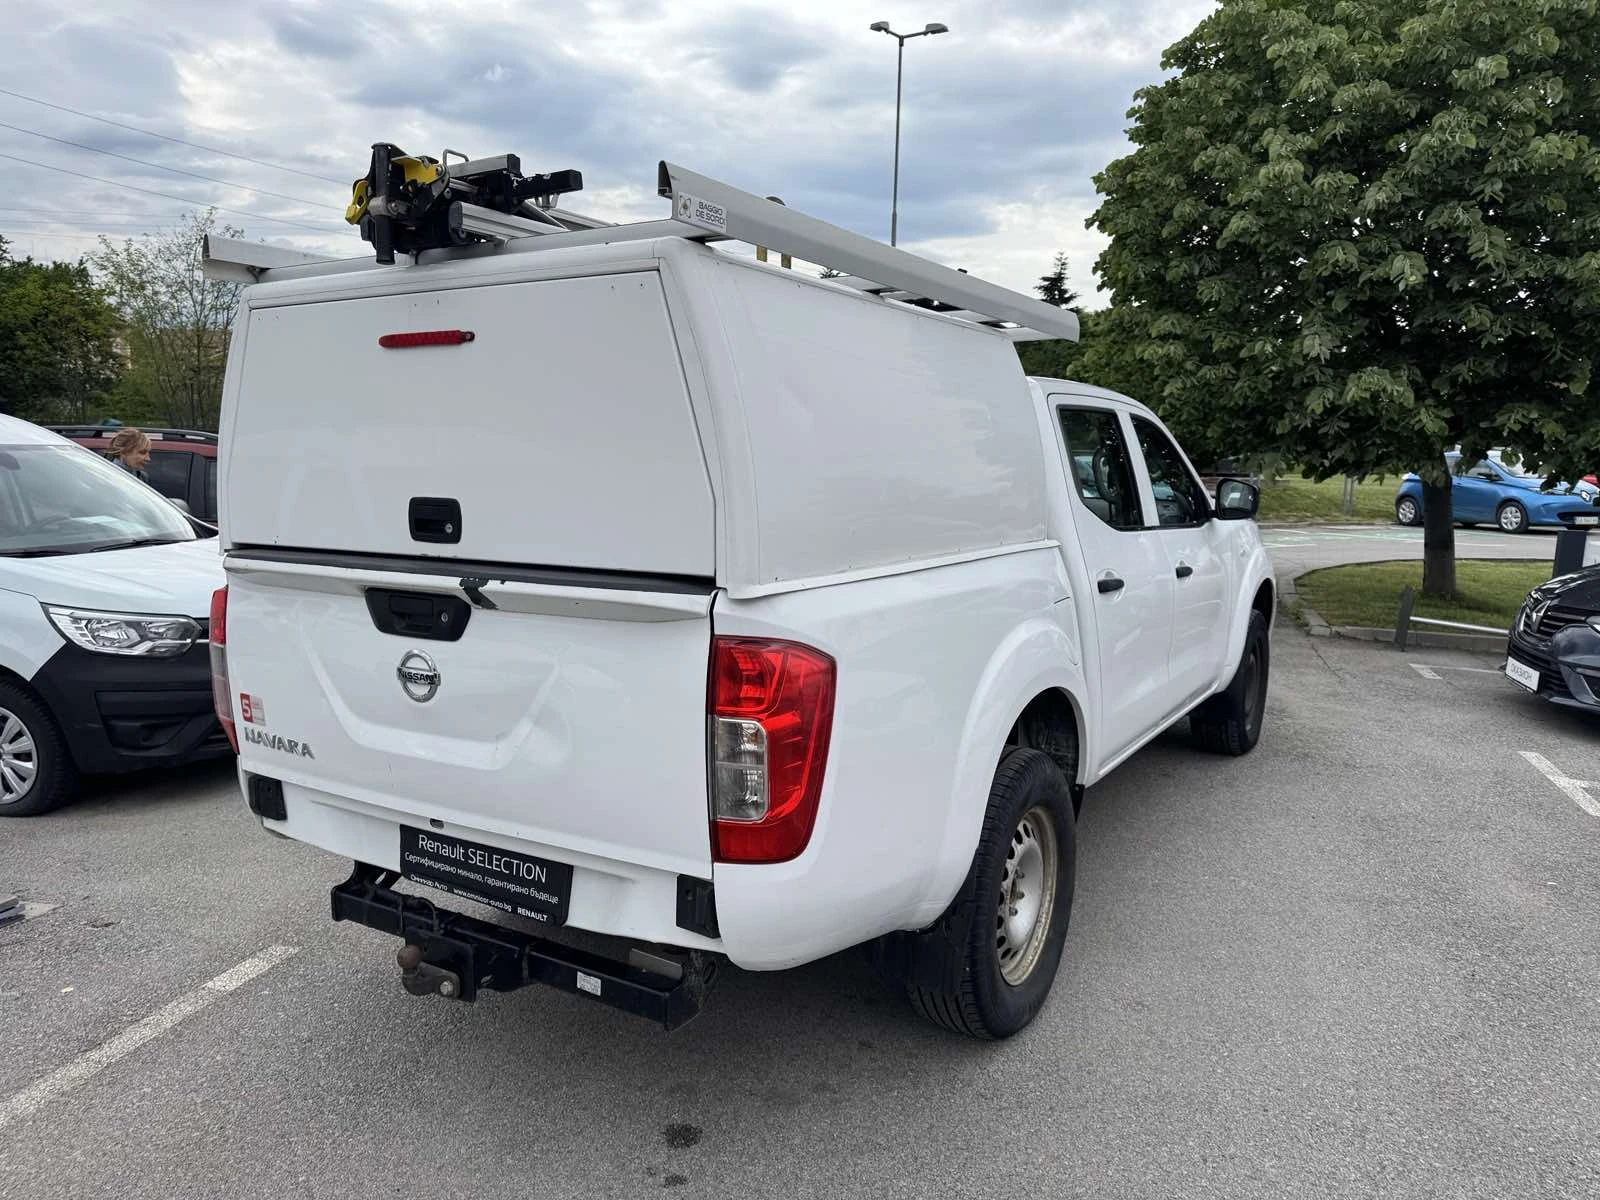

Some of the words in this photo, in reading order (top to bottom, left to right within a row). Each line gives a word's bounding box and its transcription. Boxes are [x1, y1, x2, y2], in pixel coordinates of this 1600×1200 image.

[695, 209, 705, 219] DE
[399, 670, 436, 683] NISSAN
[242, 699, 251, 718] 5
[244, 727, 315, 759] NAVARA
[418, 834, 464, 862] Renault
[467, 848, 547, 884] SELECTION
[404, 852, 456, 872] Сертифицирано
[457, 869, 484, 883] минало,
[484, 877, 529, 895] гарантирано
[529, 886, 559, 904] бъдеще
[517, 907, 548, 922] RENAULT
